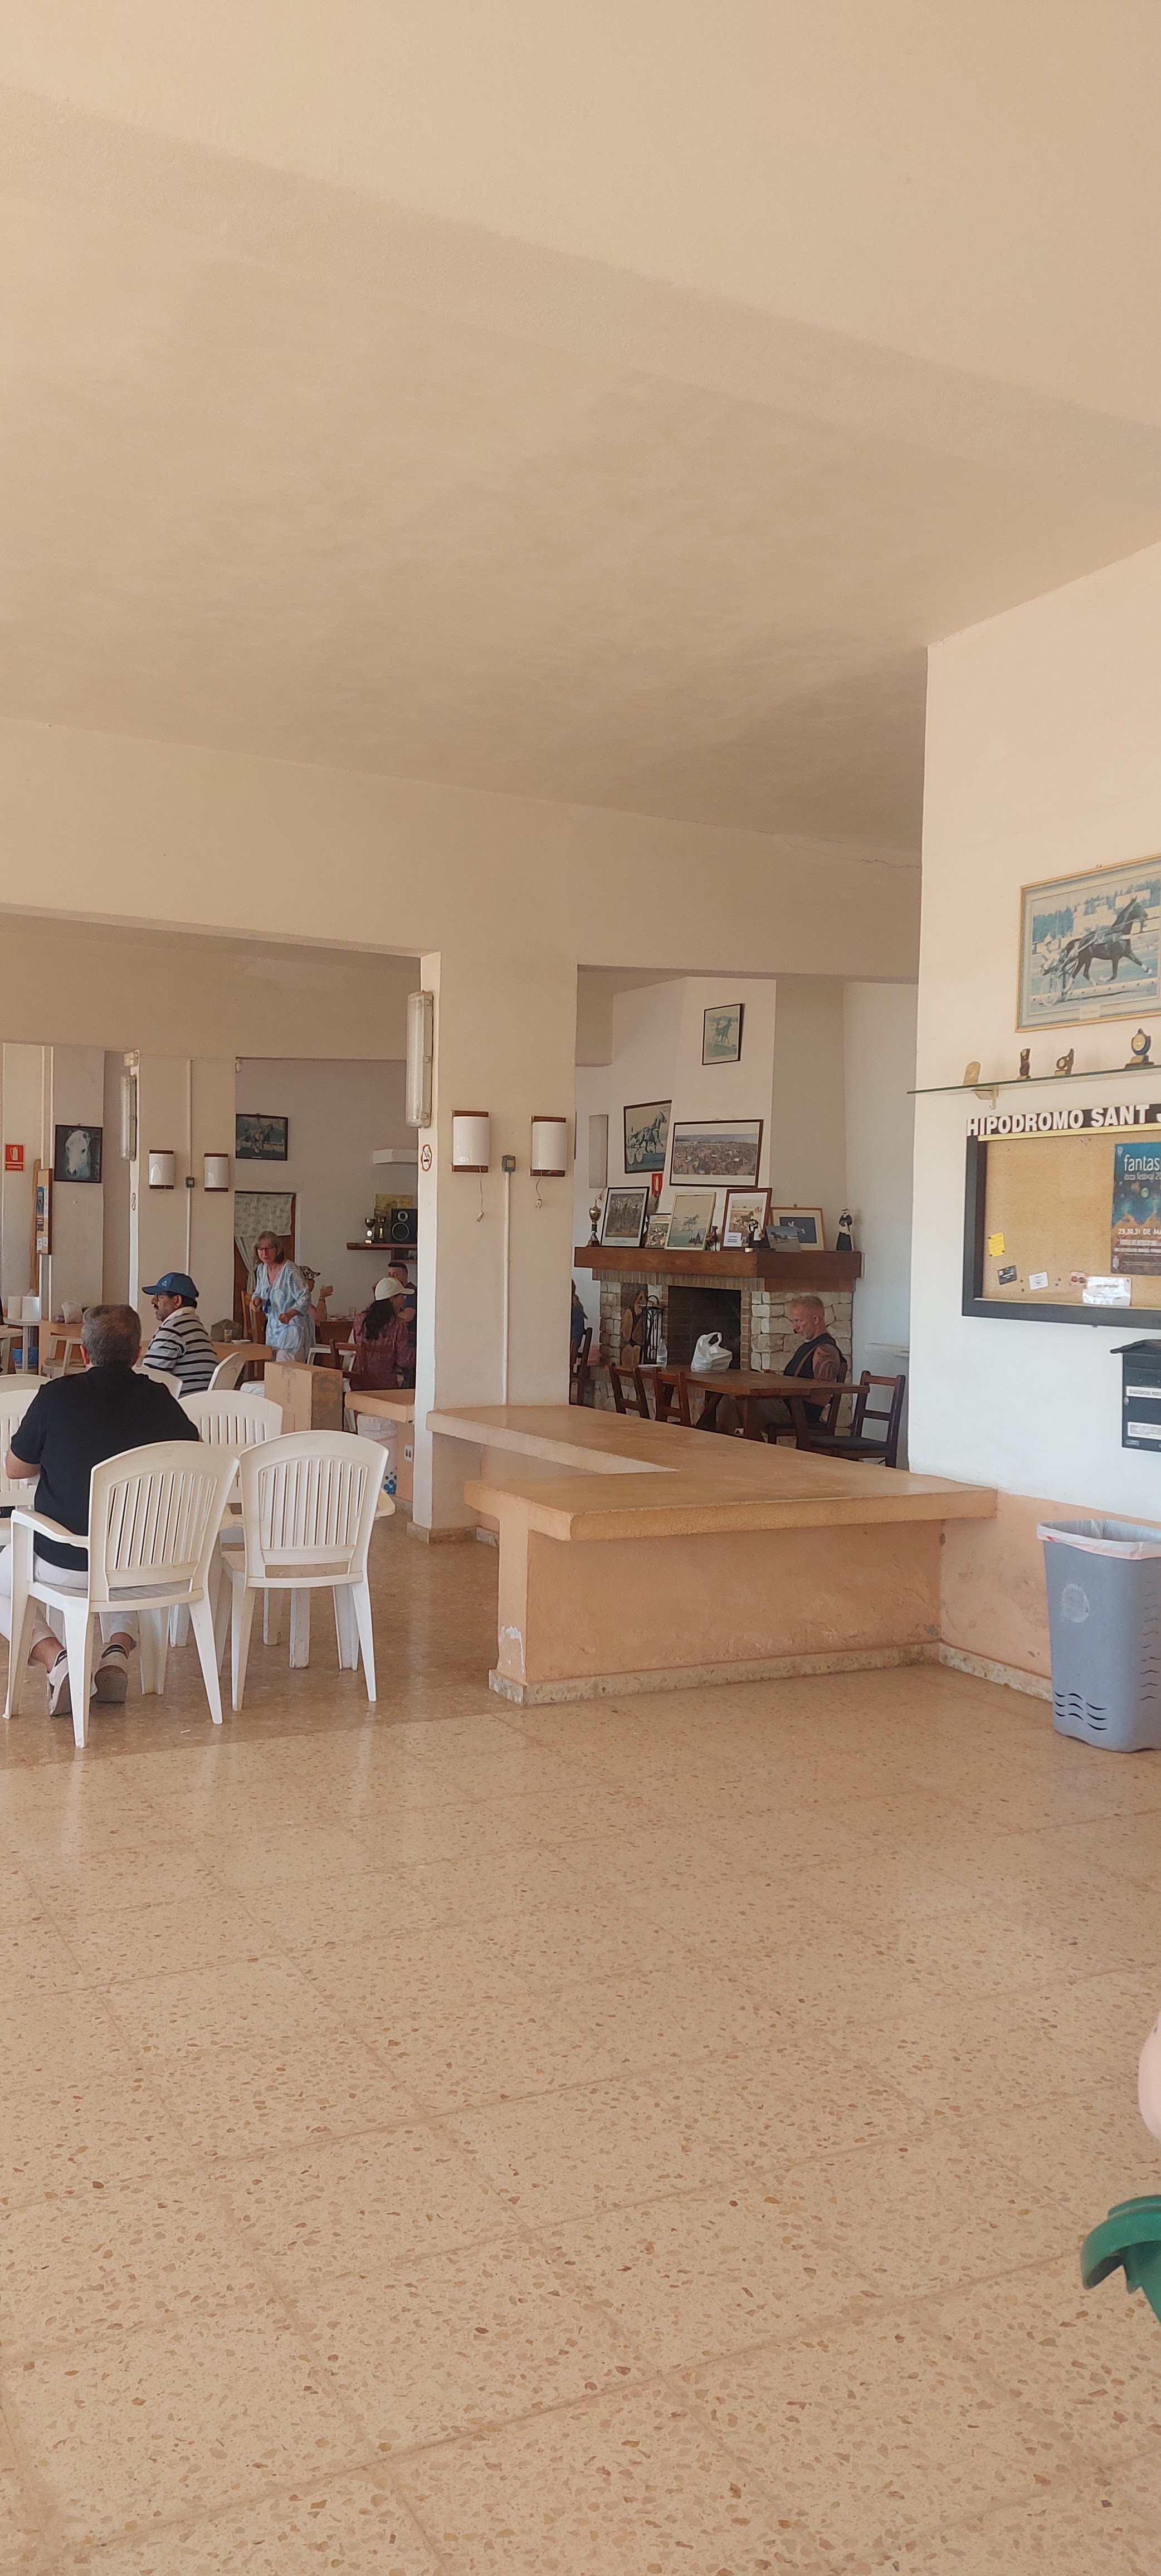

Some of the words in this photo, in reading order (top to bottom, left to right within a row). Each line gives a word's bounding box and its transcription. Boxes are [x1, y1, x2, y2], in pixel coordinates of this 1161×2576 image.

[967, 1109, 1084, 1136] HIPODROMO
[1091, 1104, 1150, 1128] SANT
[1124, 1154, 1161, 1171] fantas
